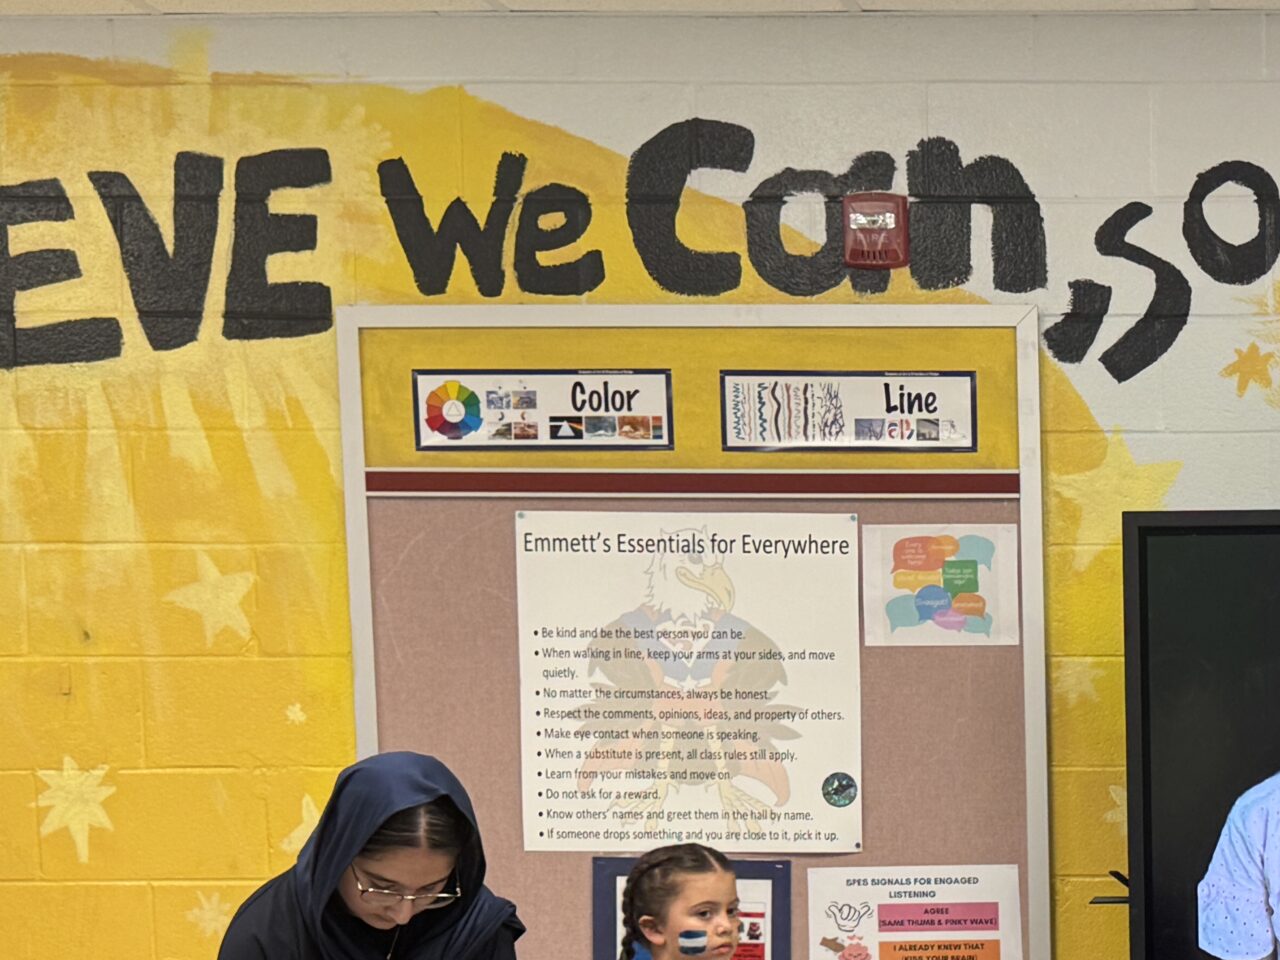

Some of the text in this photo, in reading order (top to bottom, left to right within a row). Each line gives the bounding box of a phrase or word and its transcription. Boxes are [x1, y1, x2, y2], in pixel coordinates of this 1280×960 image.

[378, 151, 606, 298] We
[571, 380, 640, 414] Color
[885, 381, 938, 413] Line
[524, 531, 849, 558] Emmett's Essentials for Everywhere
[542, 627, 745, 642] Be kind and be the best person you can be.
[542, 647, 835, 662] When walking in line, keep your arms at your sides, and move
[542, 667, 578, 680] quietly.
[544, 688, 771, 702] No matter the circumstances, always be honest.
[544, 708, 844, 723] Respect the comments, opinions, ideas, and property of others.
[545, 728, 760, 743] Make eye contact when someone is speaking.
[545, 748, 797, 763] When a substitute is present, all class rules still apply.
[546, 768, 733, 782] Learn from your mistakes and move on.
[546, 788, 661, 800] Do not ask for a reward.
[547, 808, 813, 823] Know others' names and greet them in the hall by name.
[548, 828, 838, 844] If someone drops something and you are close to it, pick it up.
[913, 877, 932, 885] FOR
